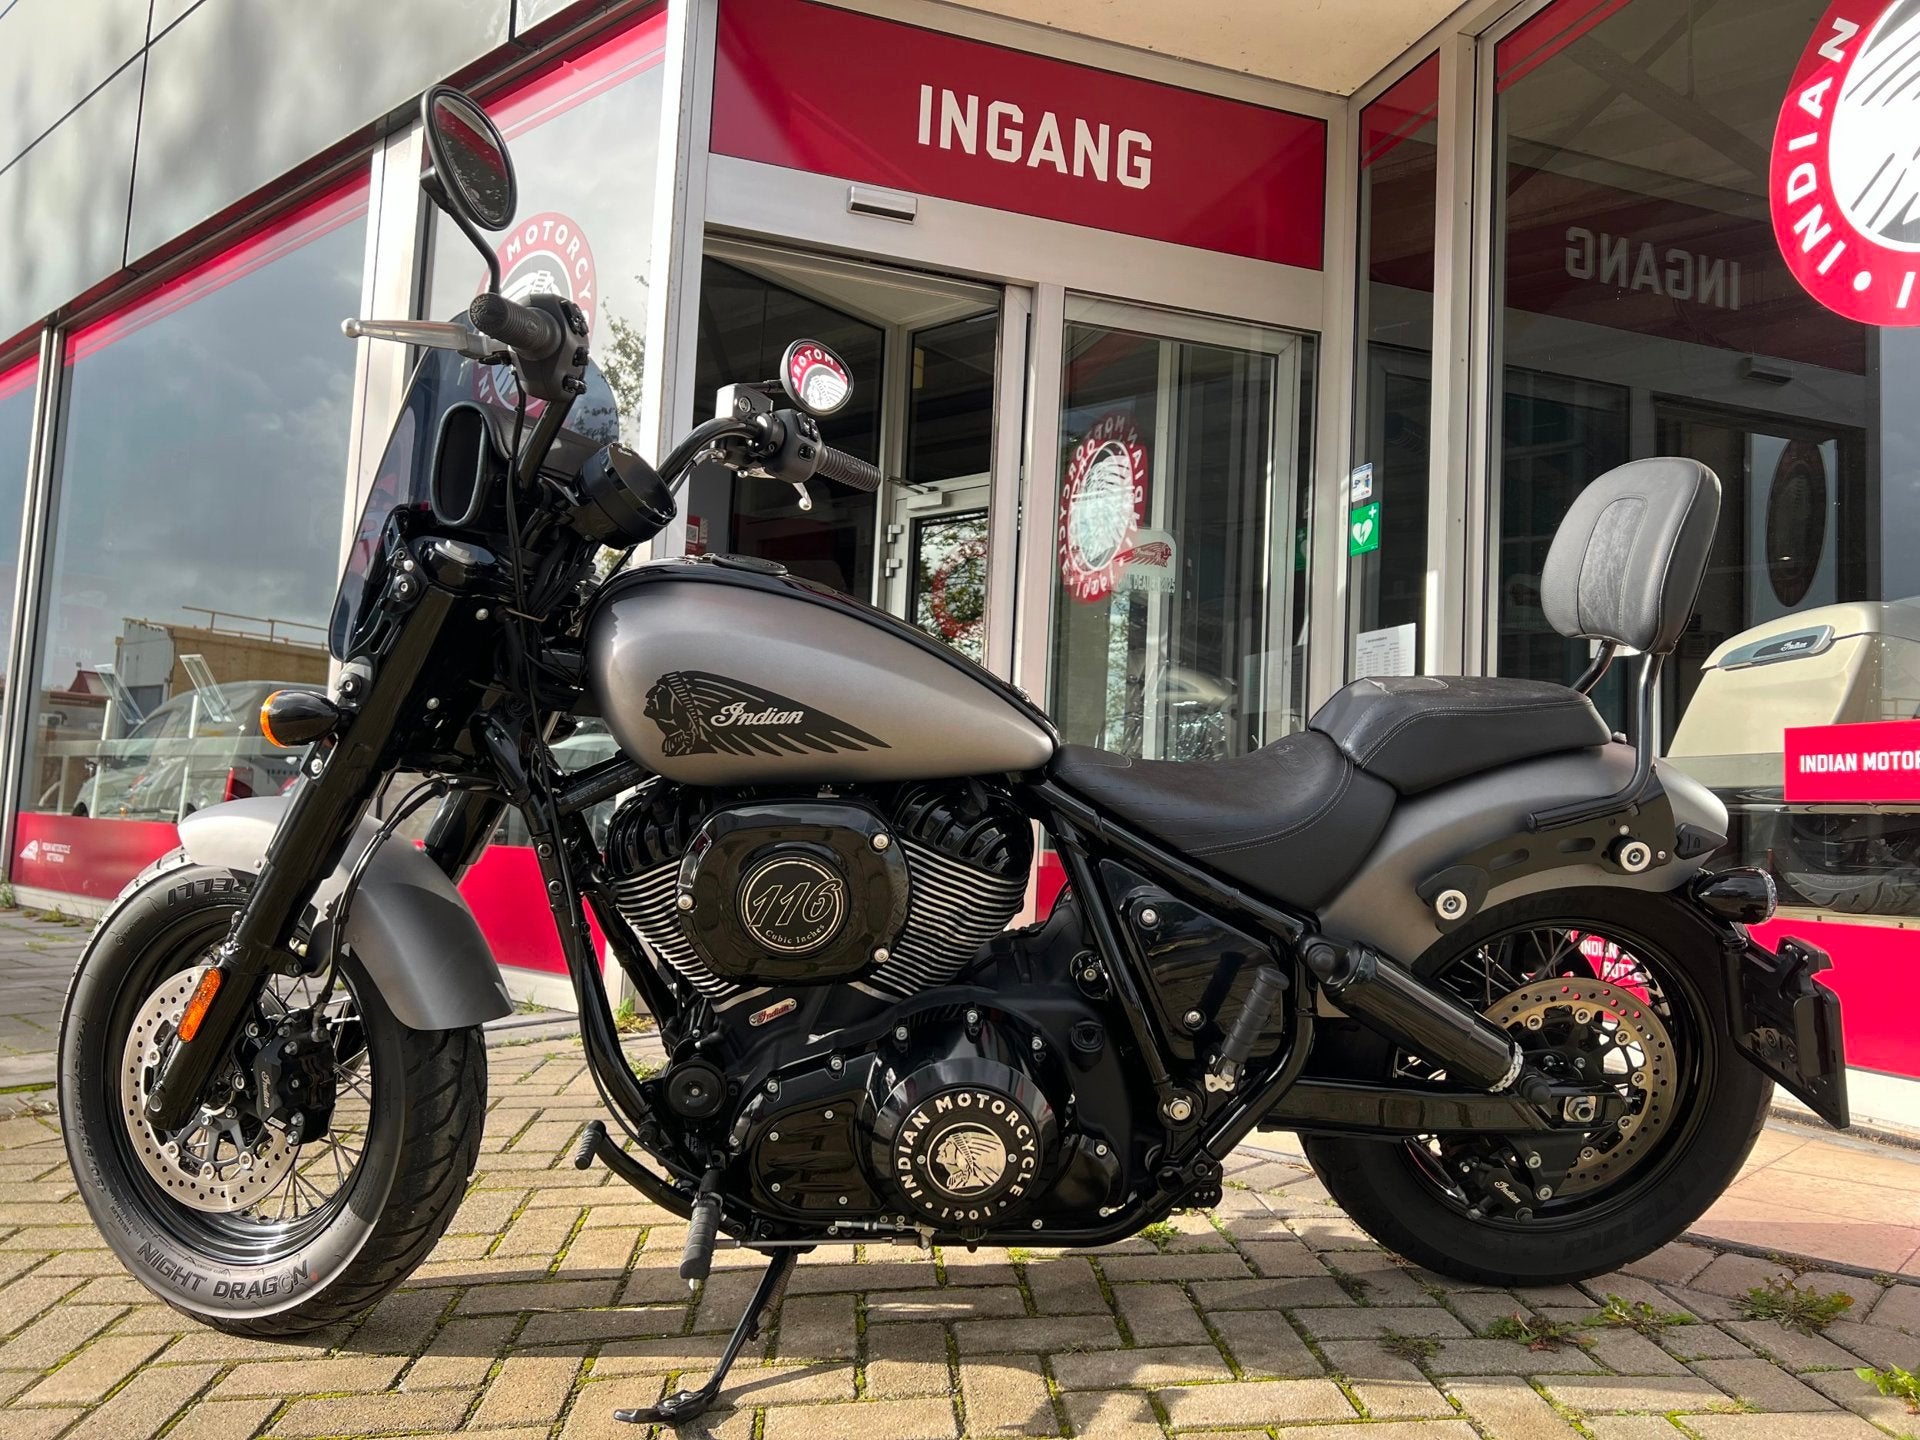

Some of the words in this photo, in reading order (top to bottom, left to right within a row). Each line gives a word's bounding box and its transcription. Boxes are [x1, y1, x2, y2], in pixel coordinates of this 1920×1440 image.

[918, 84, 1152, 190] INGANG
[1787, 17, 1860, 276] INDIAN
[506, 220, 592, 325] MOTORCY
[710, 701, 804, 727] Indian
[1800, 754, 1858, 773] INDIAN
[167, 877, 253, 907] RELLI
[750, 877, 843, 928] 116
[765, 928, 793, 945] Cubic
[796, 922, 826, 944] Inches
[1580, 939, 1618, 959] INDIN
[756, 1004, 791, 1024] Indian
[261, 1070, 272, 1109] Indian
[898, 1110, 931, 1199] INDIAN
[935, 1093, 1035, 1197] MOTORCYCLE
[1494, 1181, 1521, 1204] Indian
[941, 1206, 991, 1221] 1901
[136, 1240, 208, 1293] NIGHT
[212, 1259, 308, 1301] DRAGON
